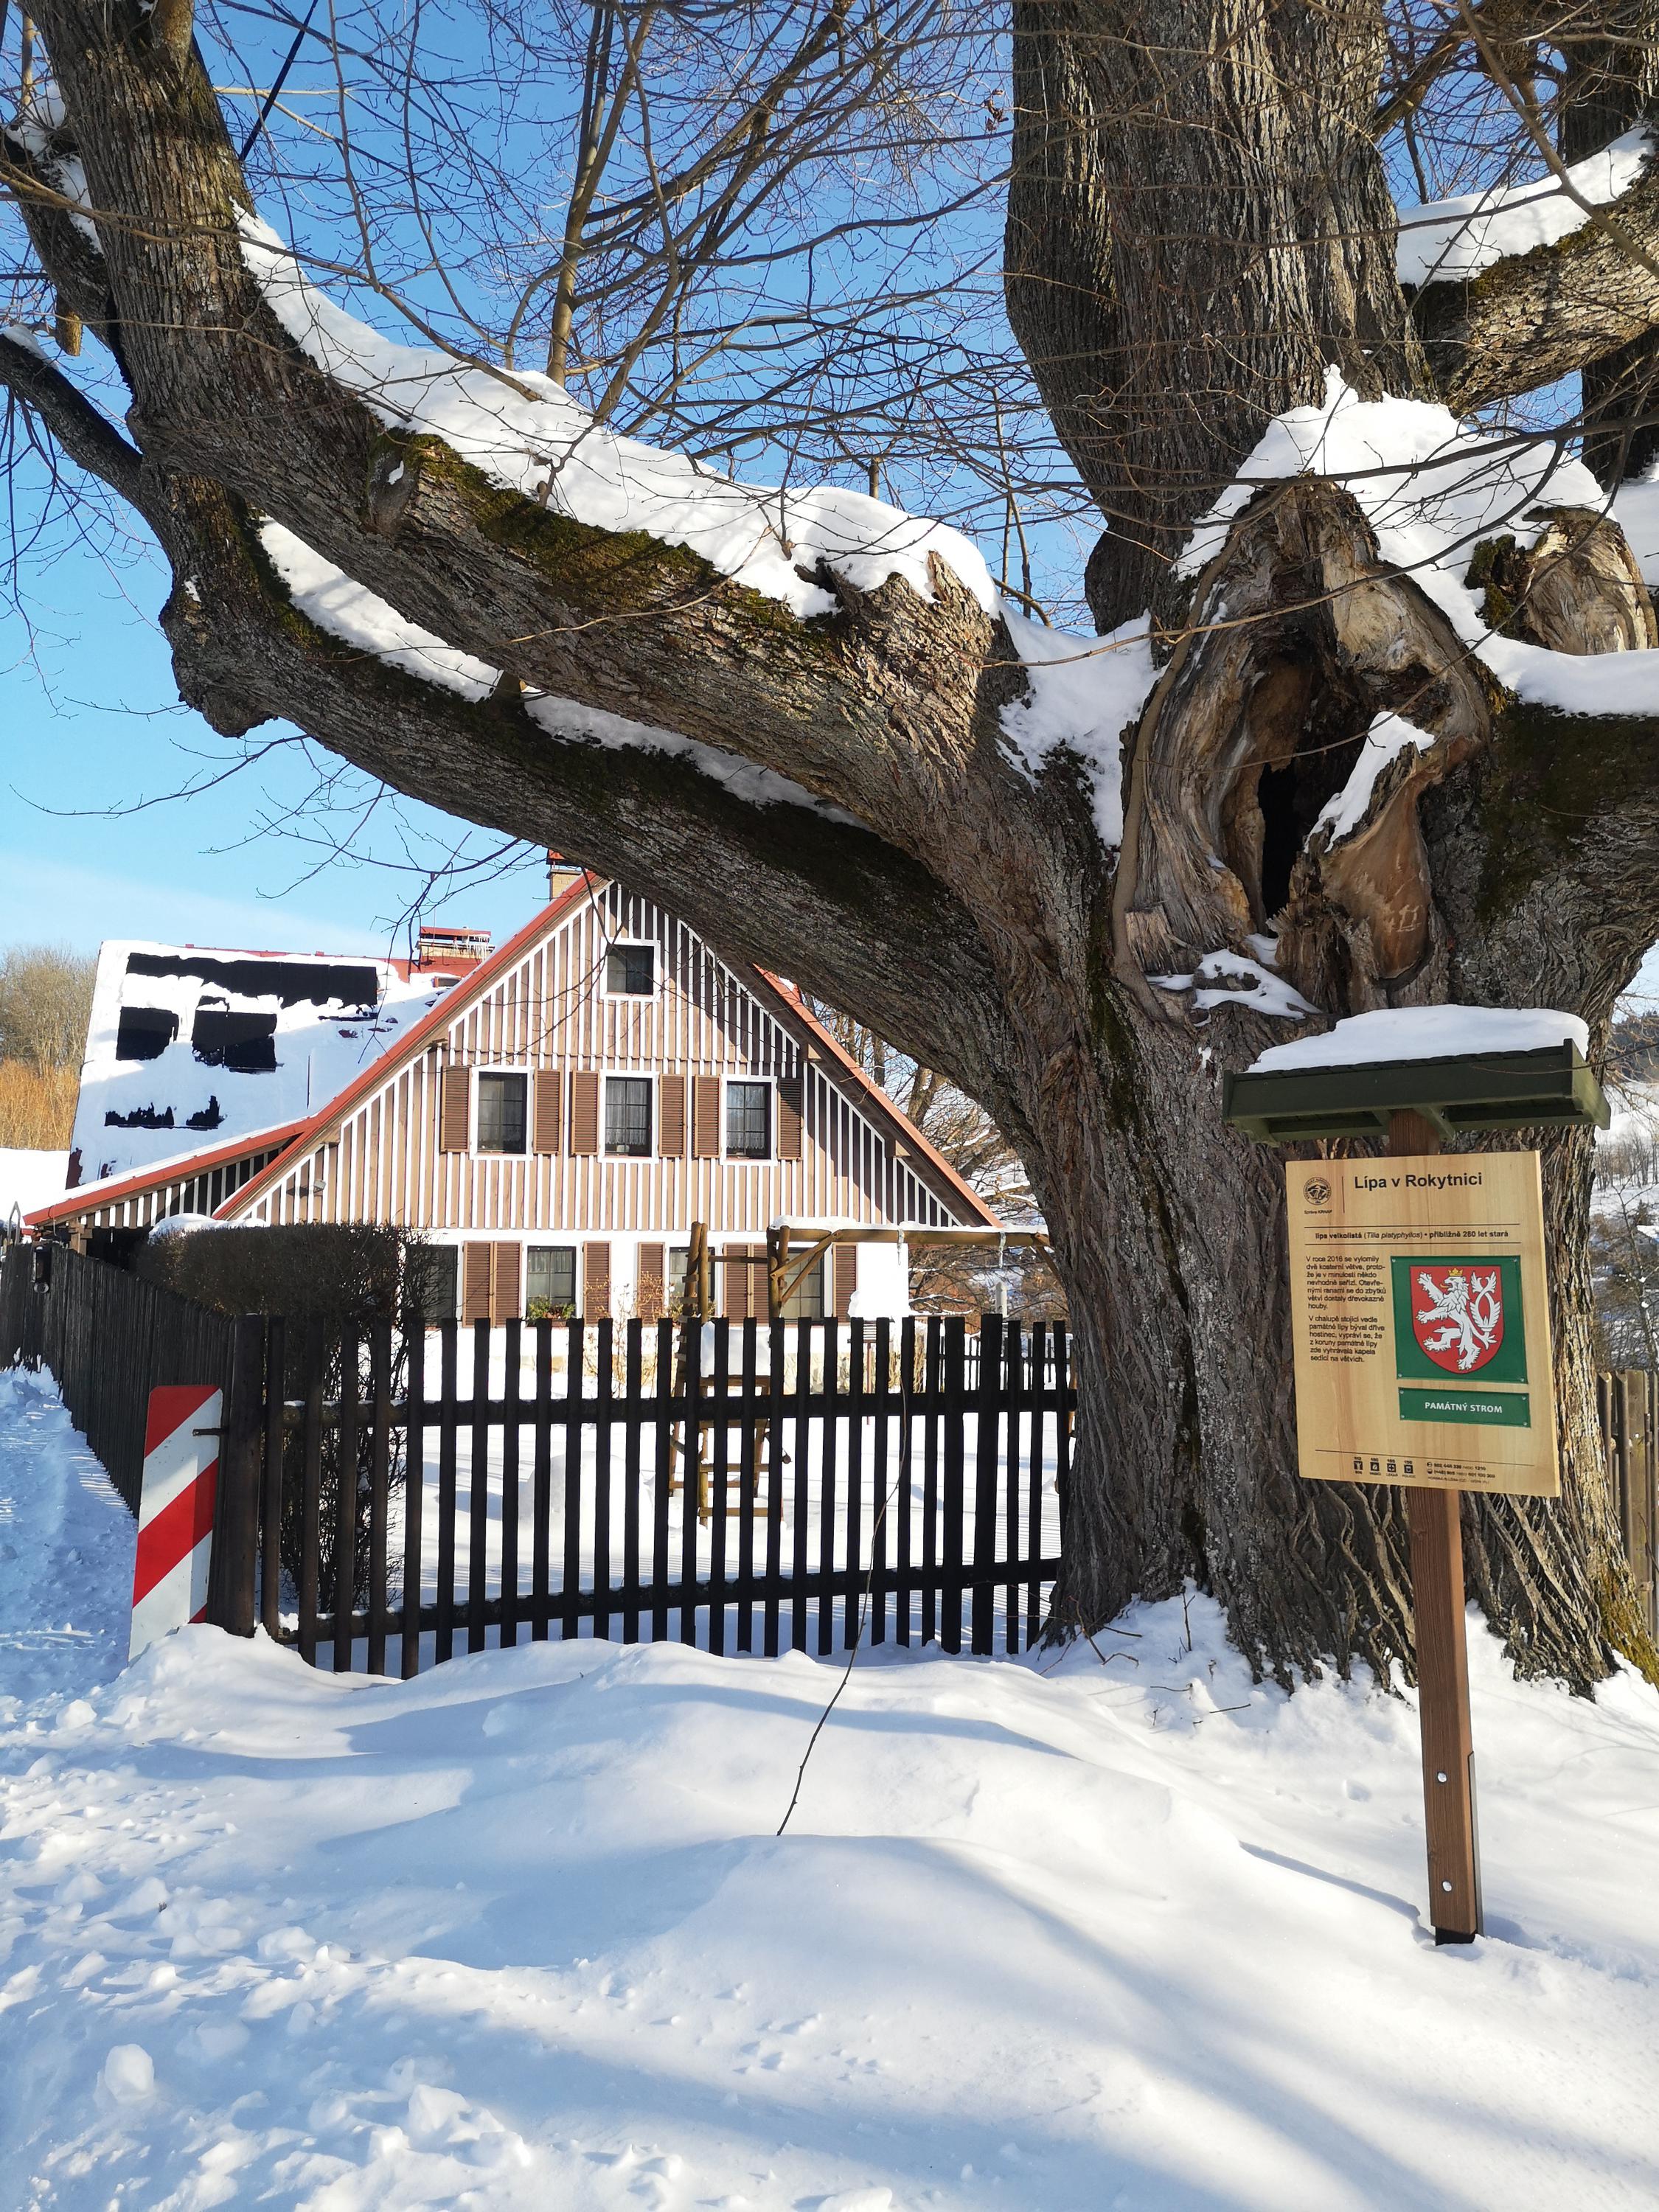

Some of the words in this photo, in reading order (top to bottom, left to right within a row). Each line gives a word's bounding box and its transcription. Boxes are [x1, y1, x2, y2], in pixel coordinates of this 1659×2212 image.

[1354, 1175, 1386, 1191] Lípa
[1392, 1178, 1400, 1188] v
[1405, 1172, 1482, 1189] Rokytnici
[1425, 1401, 1467, 1411] PAMÁTNÝ
[1470, 1405, 1503, 1413] STROM
